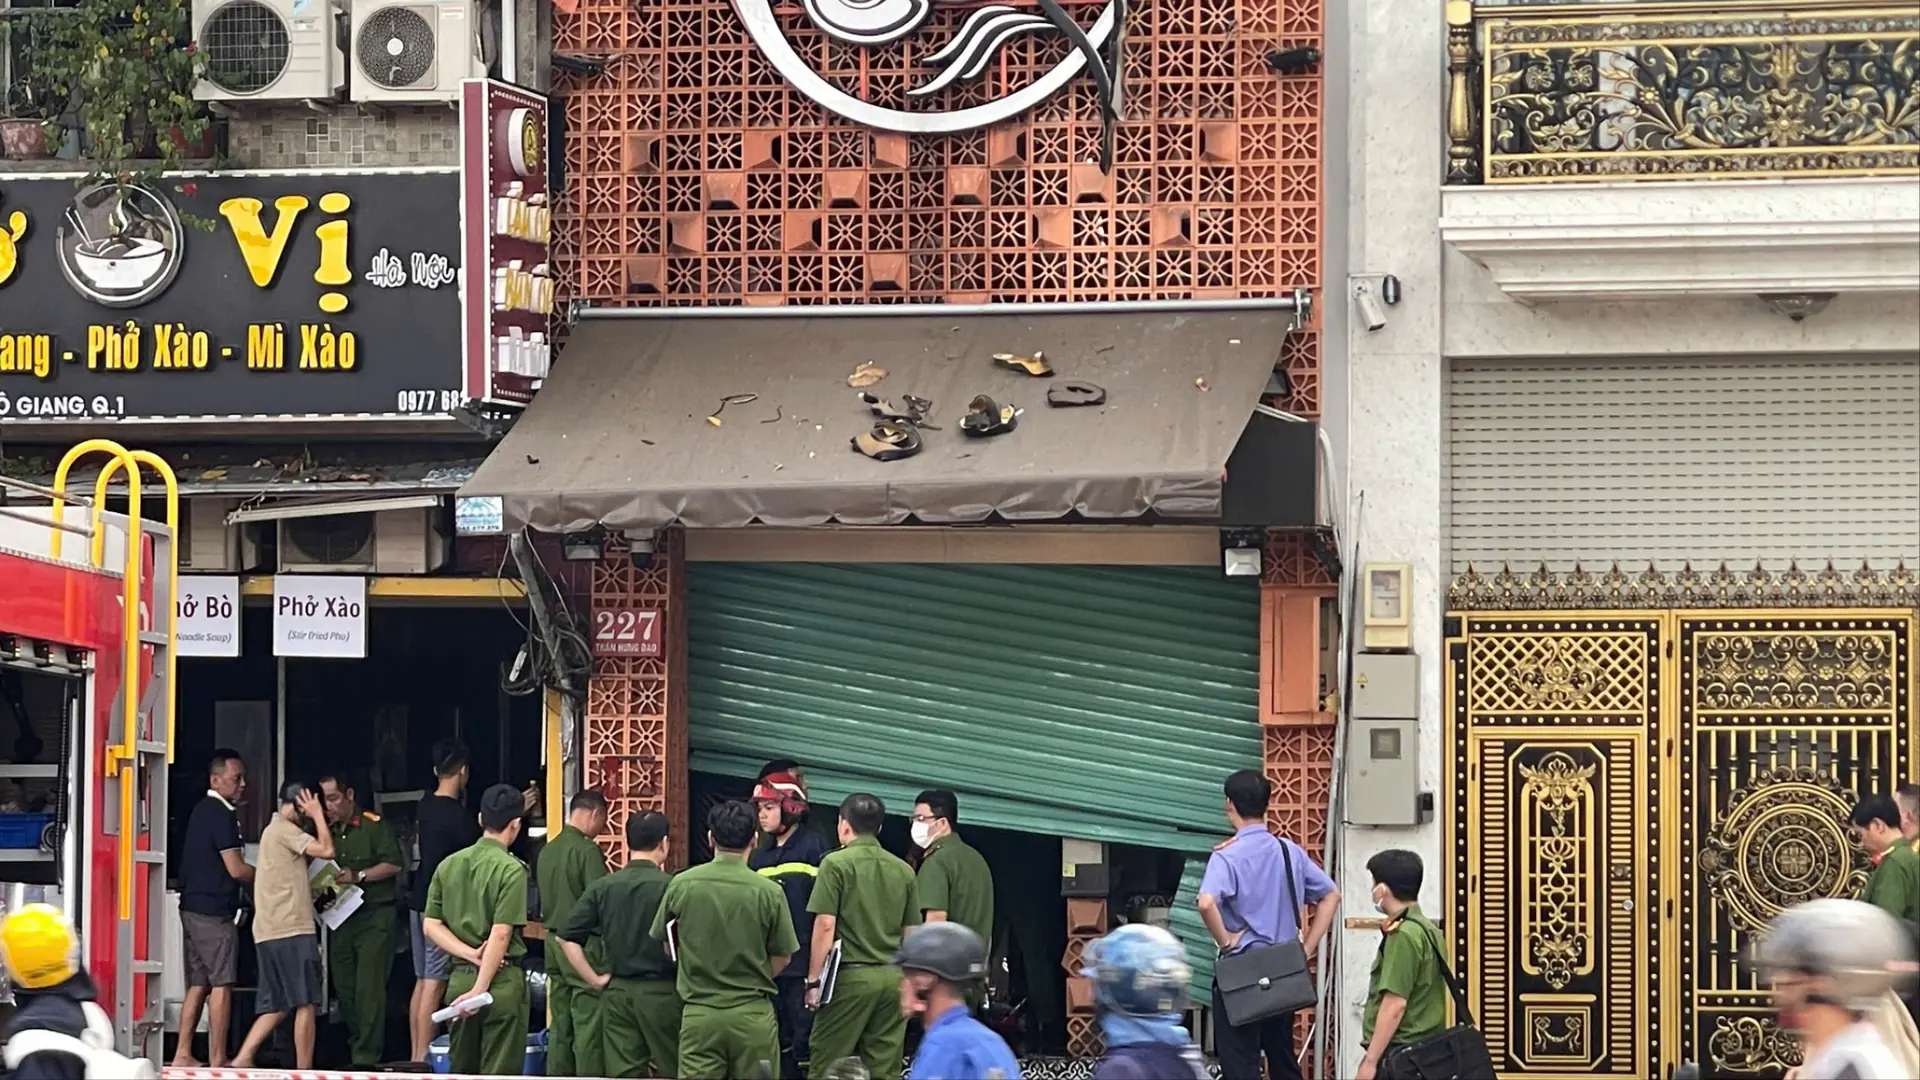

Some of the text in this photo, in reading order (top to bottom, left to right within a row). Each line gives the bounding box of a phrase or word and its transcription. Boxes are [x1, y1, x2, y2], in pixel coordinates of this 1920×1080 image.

[219, 192, 352, 312] Vị
[365, 248, 454, 289] Hà Nội
[0, 334, 49, 377] ang
[88, 320, 140, 369] Phở
[154, 323, 208, 368] Xào
[248, 323, 283, 368] Mì
[300, 324, 355, 369] Xào
[16, 395, 88, 417] GIANG,
[92, 395, 124, 415] Q.1
[398, 390, 436, 411] 0977
[176, 594, 198, 618] ở
[206, 594, 233, 618] Bò
[279, 595, 361, 618] Phở Xào
[596, 611, 657, 640] 227
